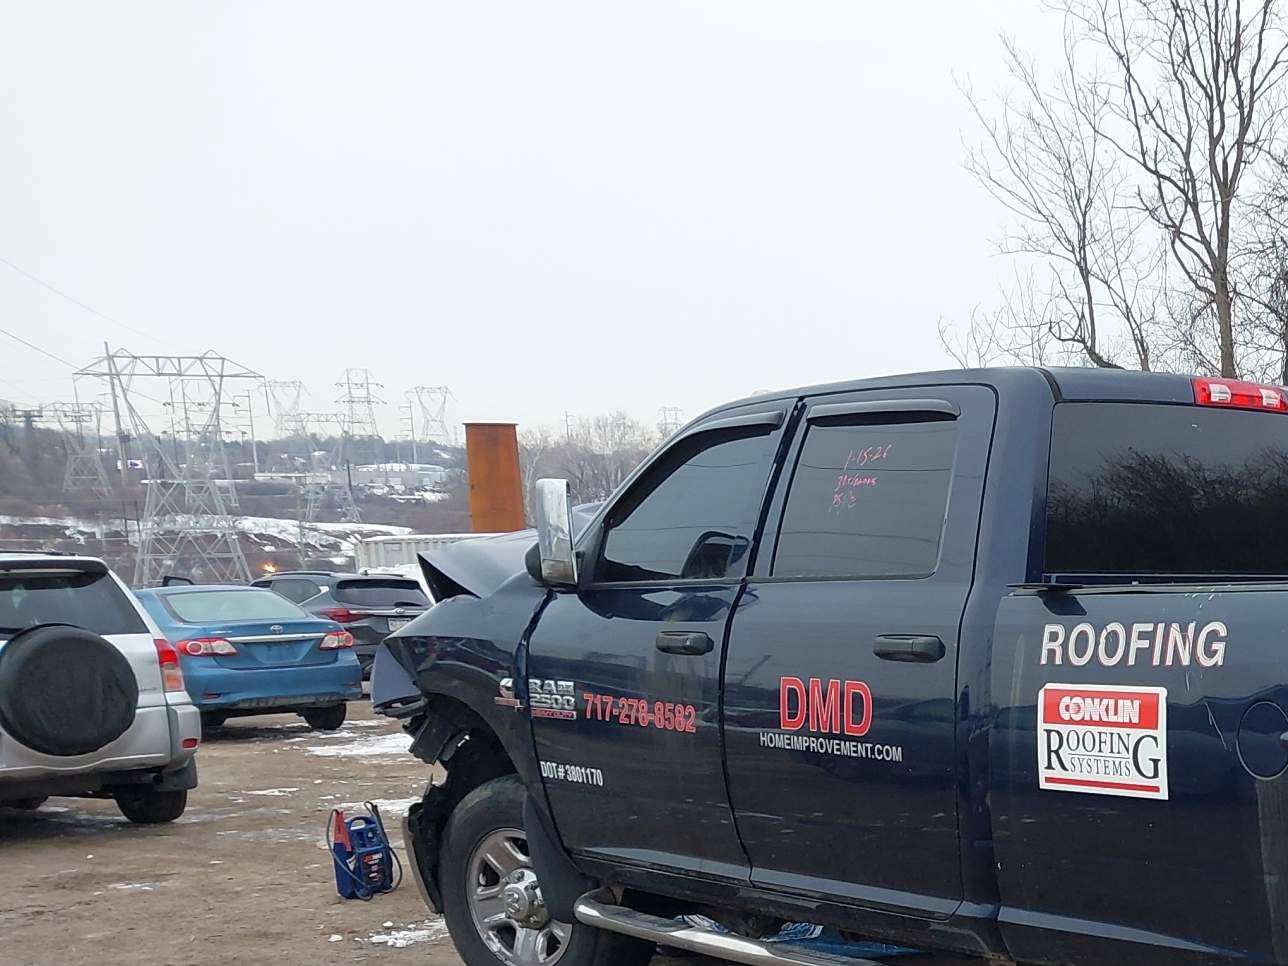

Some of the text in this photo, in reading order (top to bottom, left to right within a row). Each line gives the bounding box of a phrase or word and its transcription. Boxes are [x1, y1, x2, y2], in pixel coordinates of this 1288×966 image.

[1040, 621, 1228, 666] ROOFING
[529, 678, 575, 696] RAM
[529, 693, 575, 710] 2500
[584, 693, 697, 733] 717-278-8582
[780, 676, 873, 737] DMD
[1059, 696, 1141, 723] CONKLIN
[760, 732, 903, 762] HOMEIMPROVEMENT.COM
[1043, 728, 1161, 780] ROOFING
[1069, 756, 1131, 776] SYSTEMS
